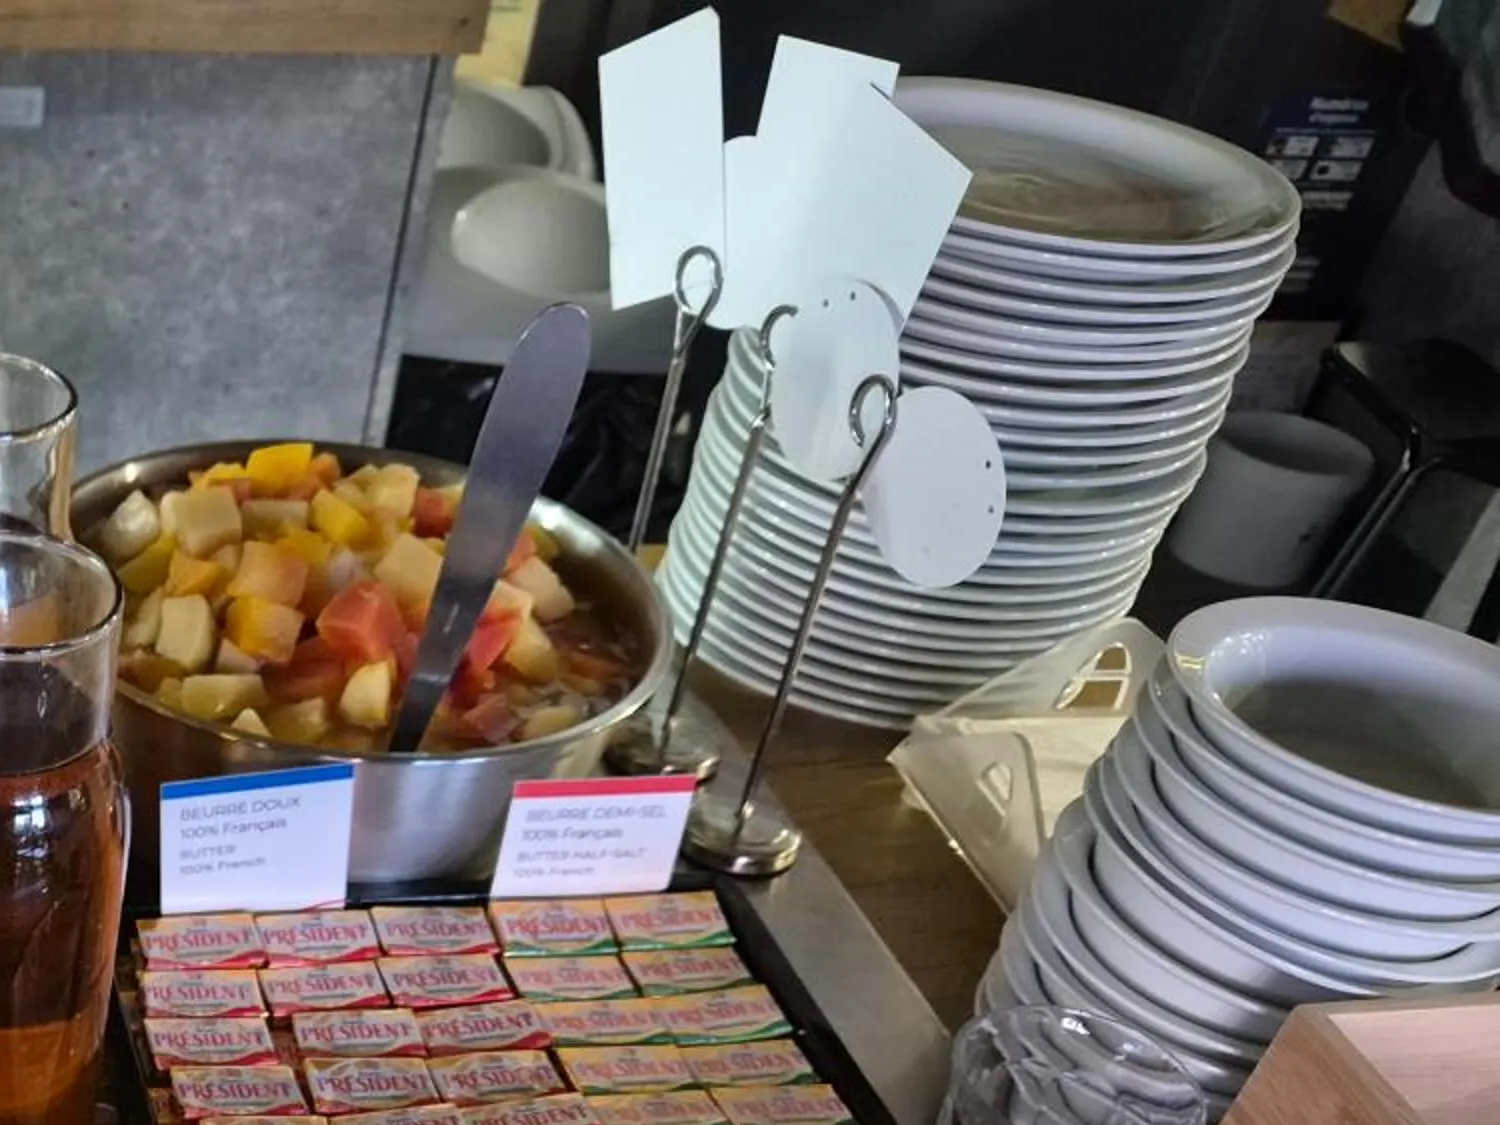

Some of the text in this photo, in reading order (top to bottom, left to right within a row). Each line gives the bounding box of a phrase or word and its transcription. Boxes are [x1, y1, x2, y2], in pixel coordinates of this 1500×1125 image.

[180, 797, 302, 822] BEURRE DOUX
[593, 804, 668, 820] DEMI-SEL
[180, 817, 288, 840] 100% Français
[522, 828, 560, 842] 100%
[180, 844, 238, 861] BUTTER
